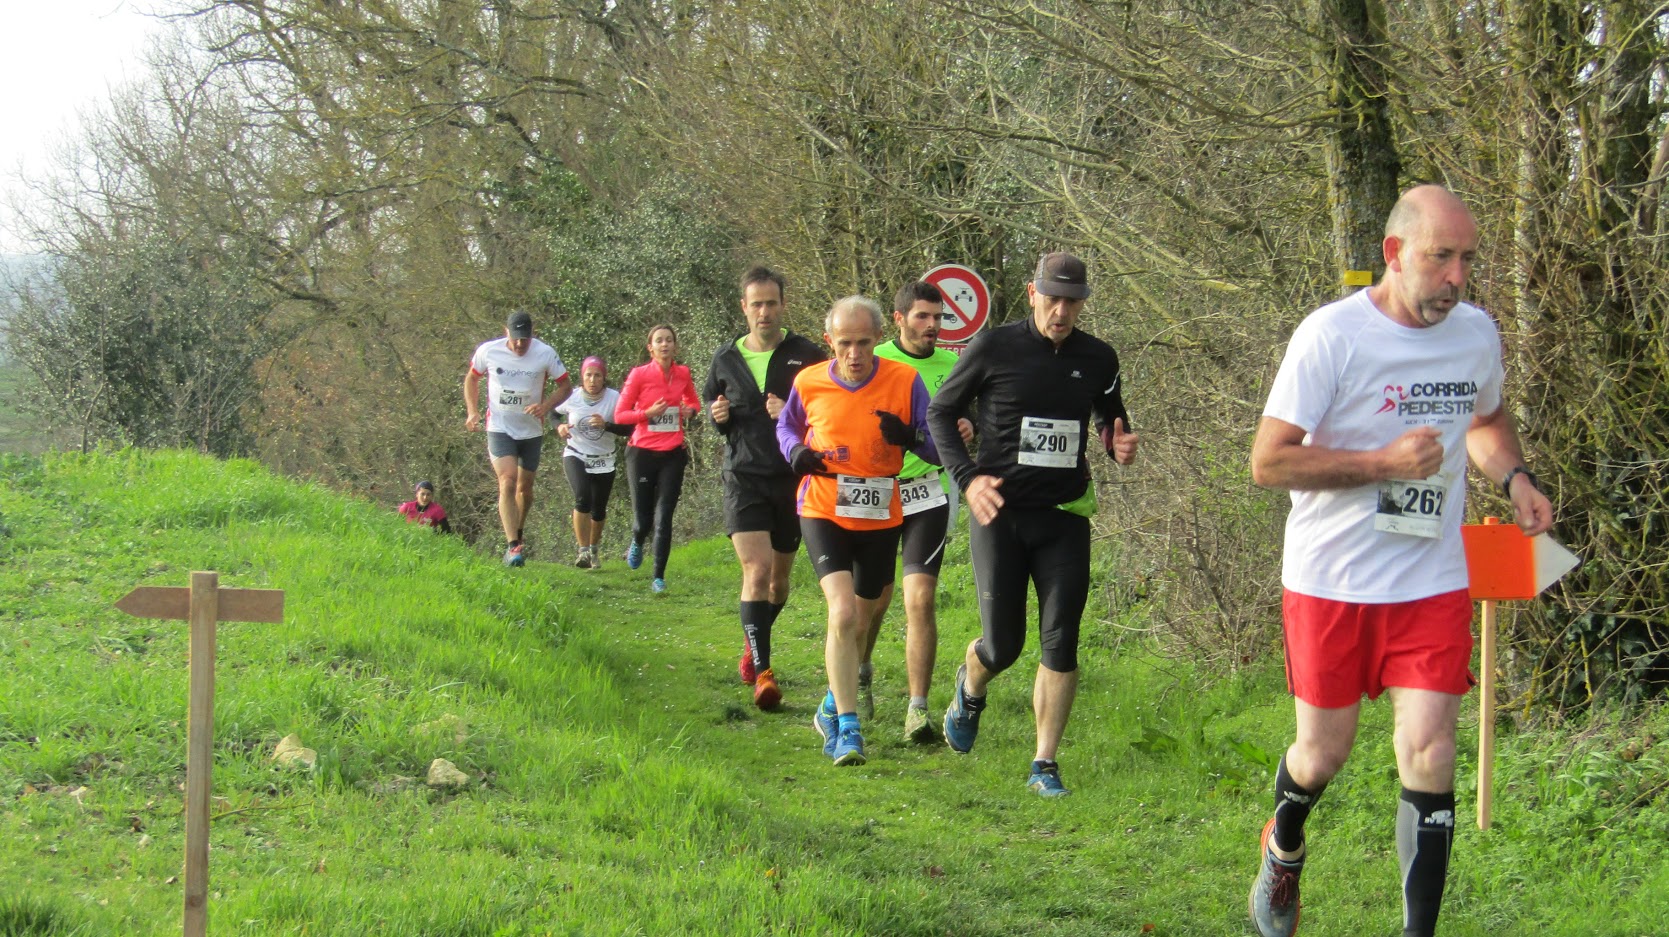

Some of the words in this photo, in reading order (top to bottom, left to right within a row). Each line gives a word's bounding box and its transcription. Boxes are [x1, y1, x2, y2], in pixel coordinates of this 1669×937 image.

[1410, 381, 1478, 397] CORRIDA
[507, 395, 523, 405] 281
[656, 414, 674, 424] 269
[1036, 433, 1067, 453] 290
[591, 459, 607, 467] 298
[851, 488, 880, 506] 236
[901, 485, 929, 504] 343
[1402, 487, 1443, 517] 262
